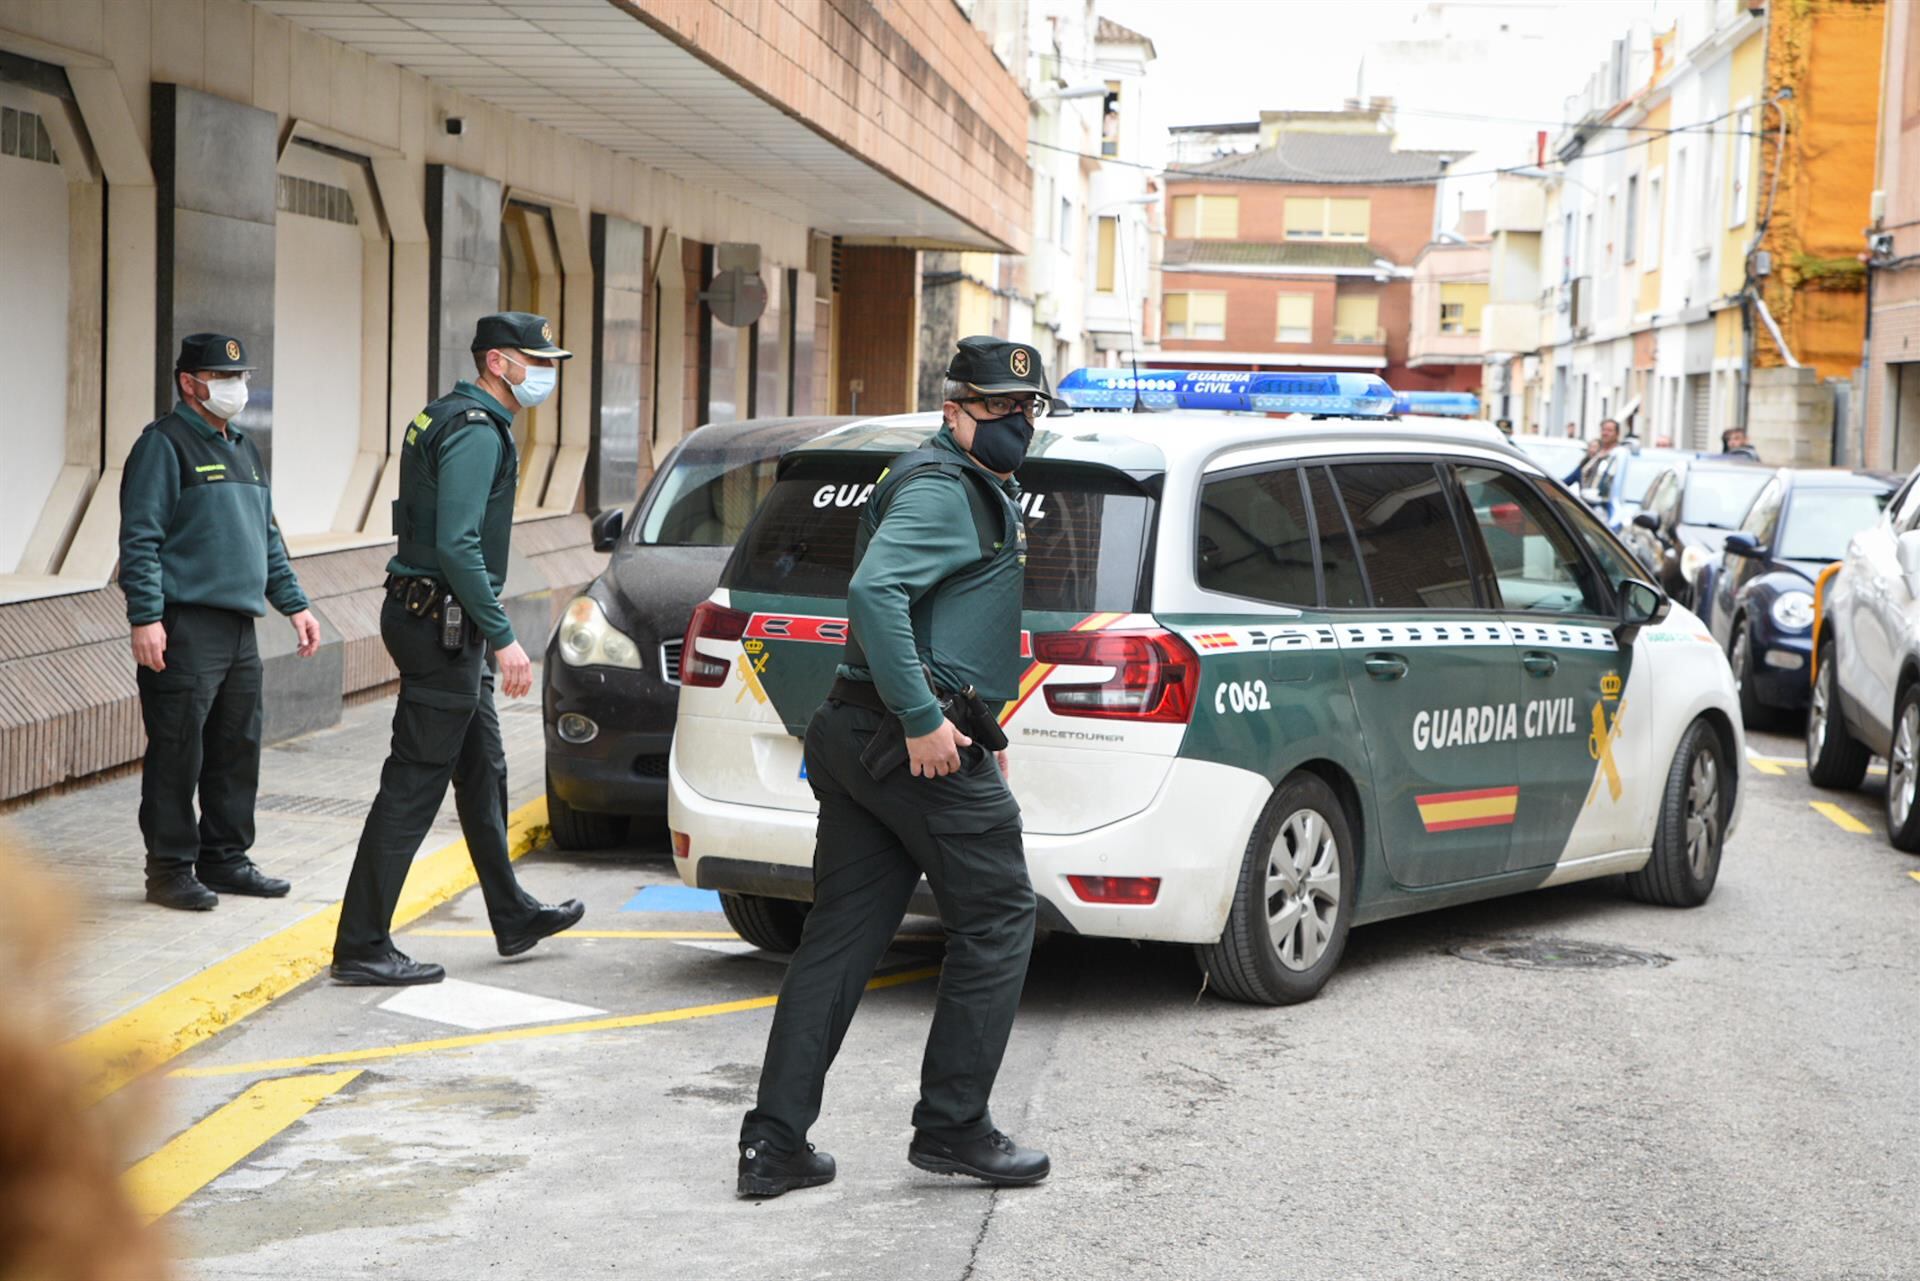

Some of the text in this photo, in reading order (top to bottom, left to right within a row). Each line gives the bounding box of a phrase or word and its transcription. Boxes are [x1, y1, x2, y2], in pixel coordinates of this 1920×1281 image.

[1186, 372, 1250, 382] GUARDIA
[1194, 382, 1232, 393] CIVIL
[812, 484, 1045, 519] GUA IL
[1412, 697, 1577, 751] GUARDIA CIVIL
[1022, 727, 1124, 742] SPACETOURER
